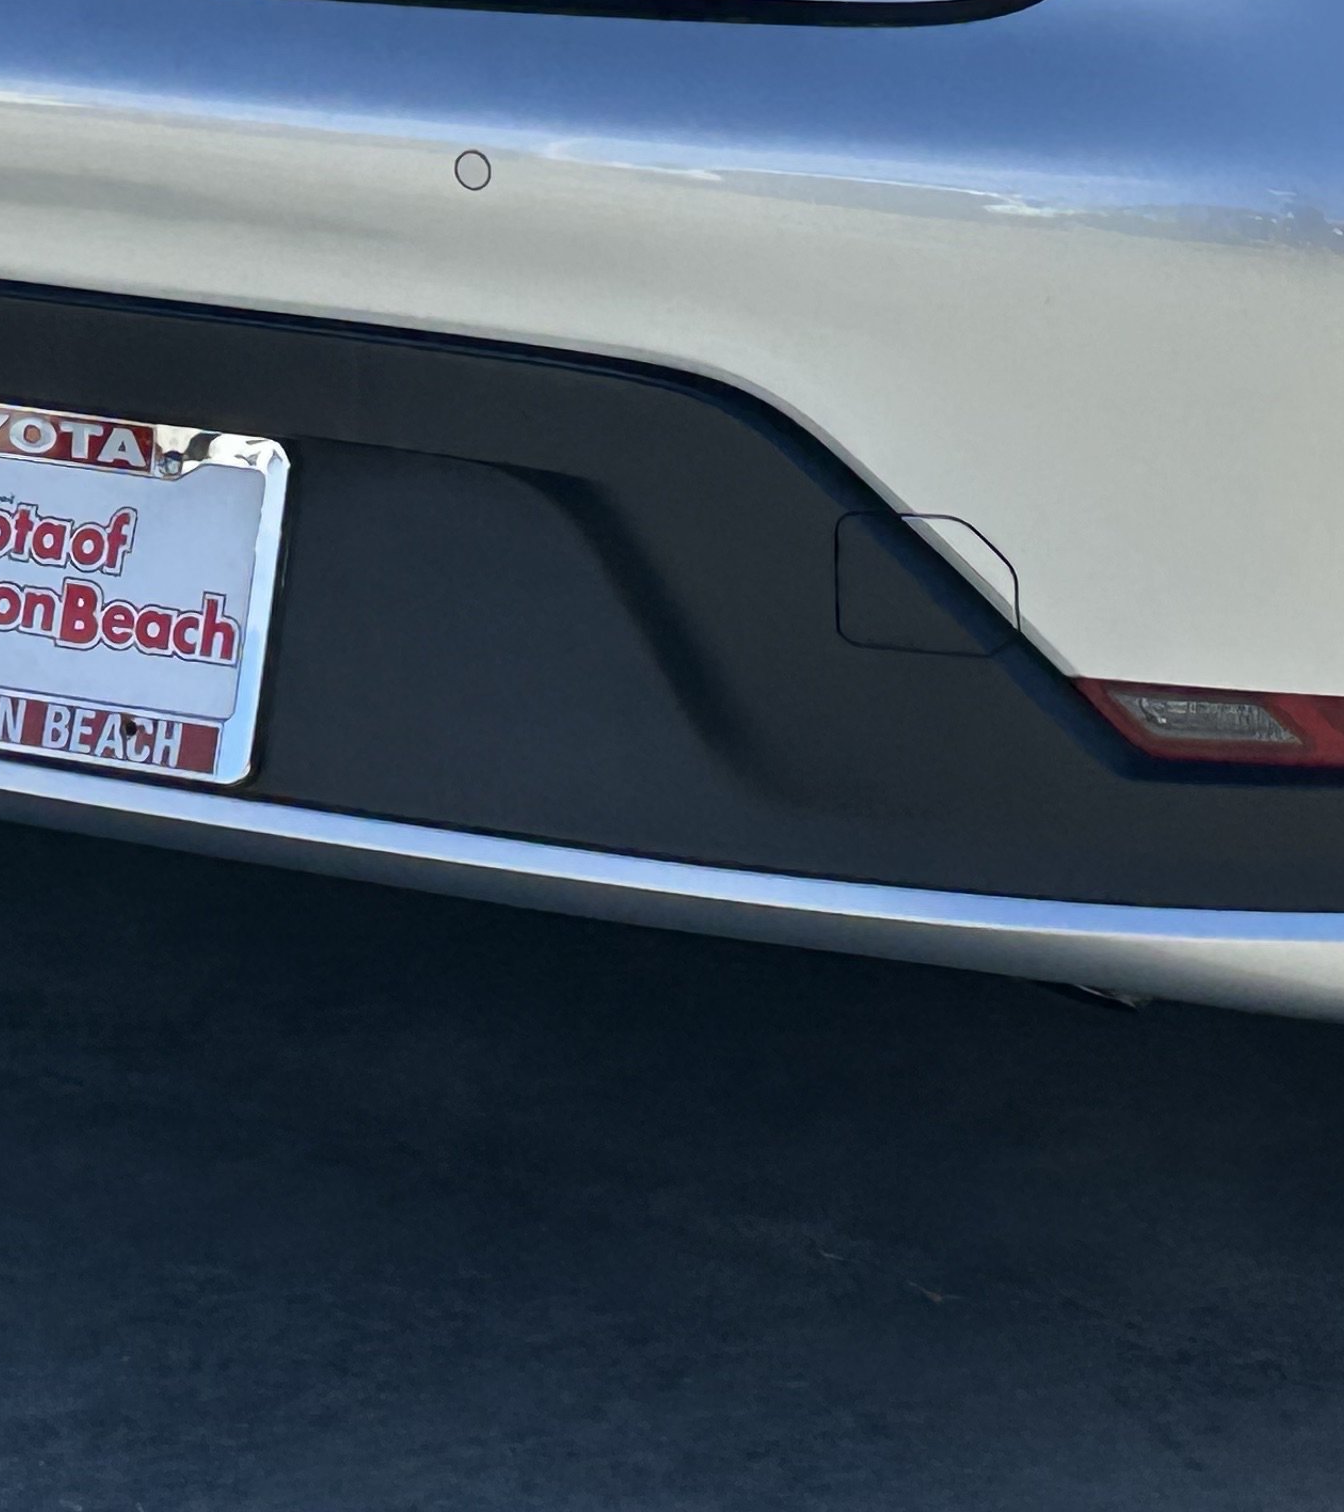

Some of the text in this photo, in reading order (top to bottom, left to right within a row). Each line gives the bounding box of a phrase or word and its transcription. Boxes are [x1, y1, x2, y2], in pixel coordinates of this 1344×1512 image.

[70, 510, 133, 571] of
[58, 583, 236, 661] Beach
[42, 705, 184, 769] BEACH
